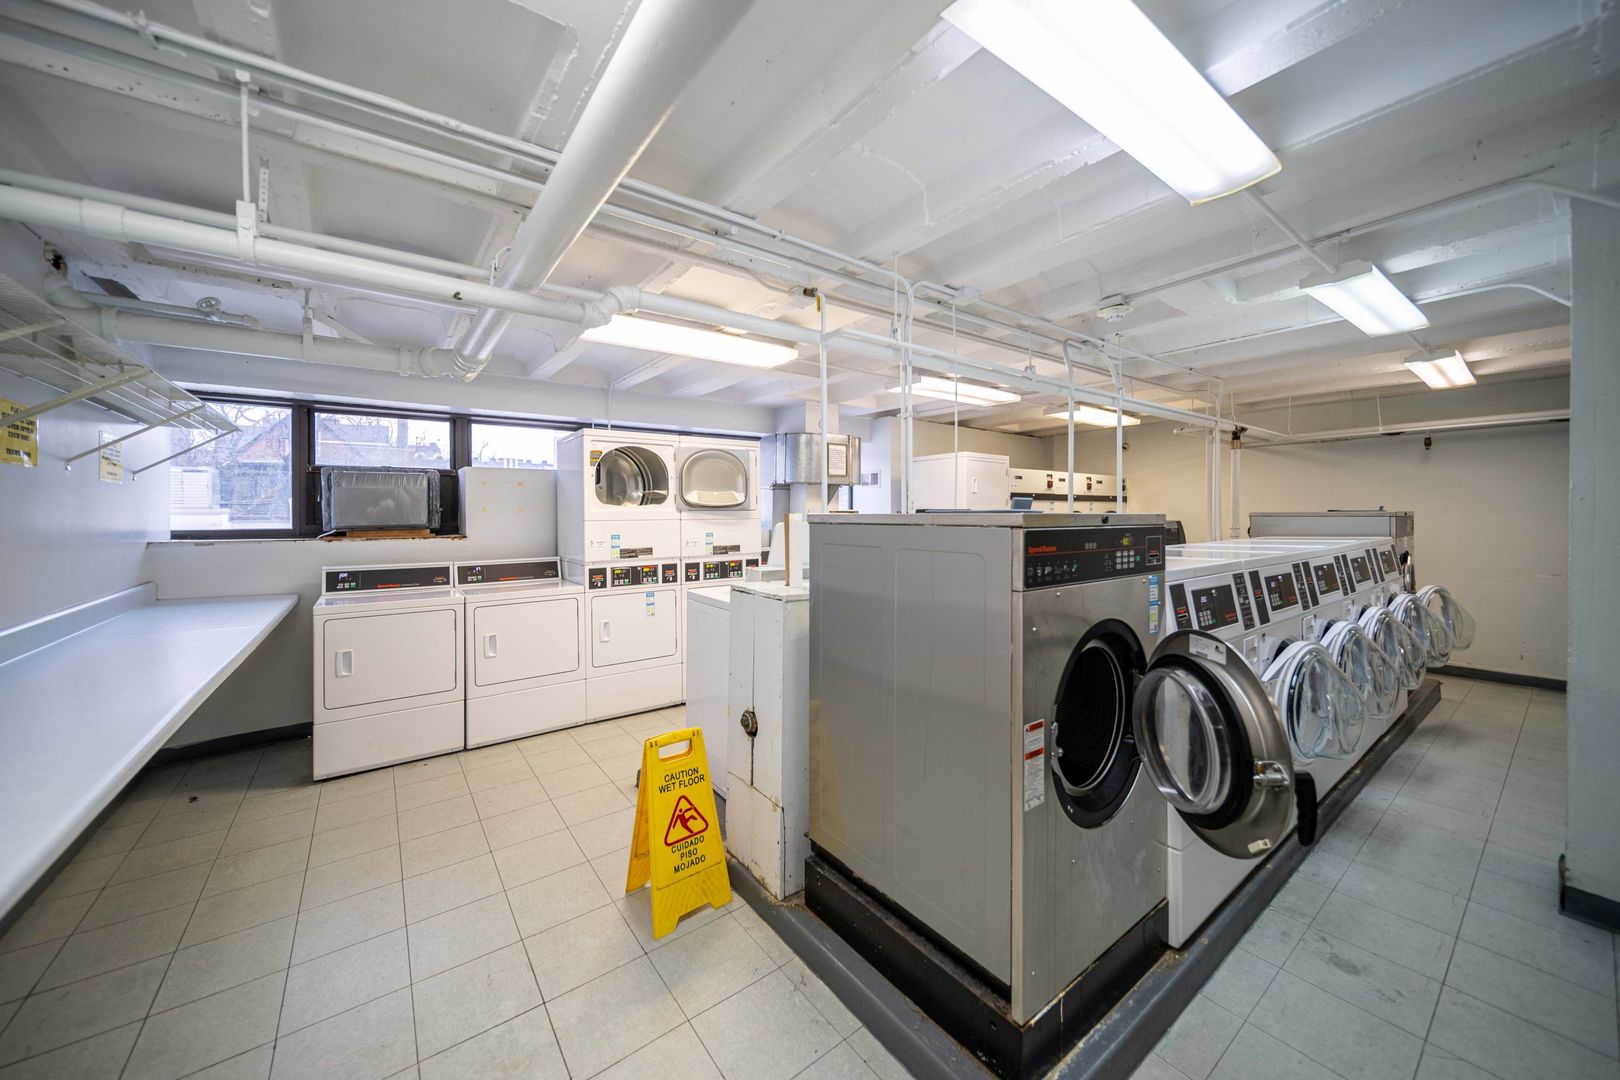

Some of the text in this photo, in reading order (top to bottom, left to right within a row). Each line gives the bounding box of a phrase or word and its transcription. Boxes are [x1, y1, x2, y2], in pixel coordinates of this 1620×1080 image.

[658, 773, 705, 794] WET FLOOR
[664, 767, 699, 783] CAUTION
[671, 835, 705, 854] CUIDADO
[673, 854, 706, 874] MOJADO
